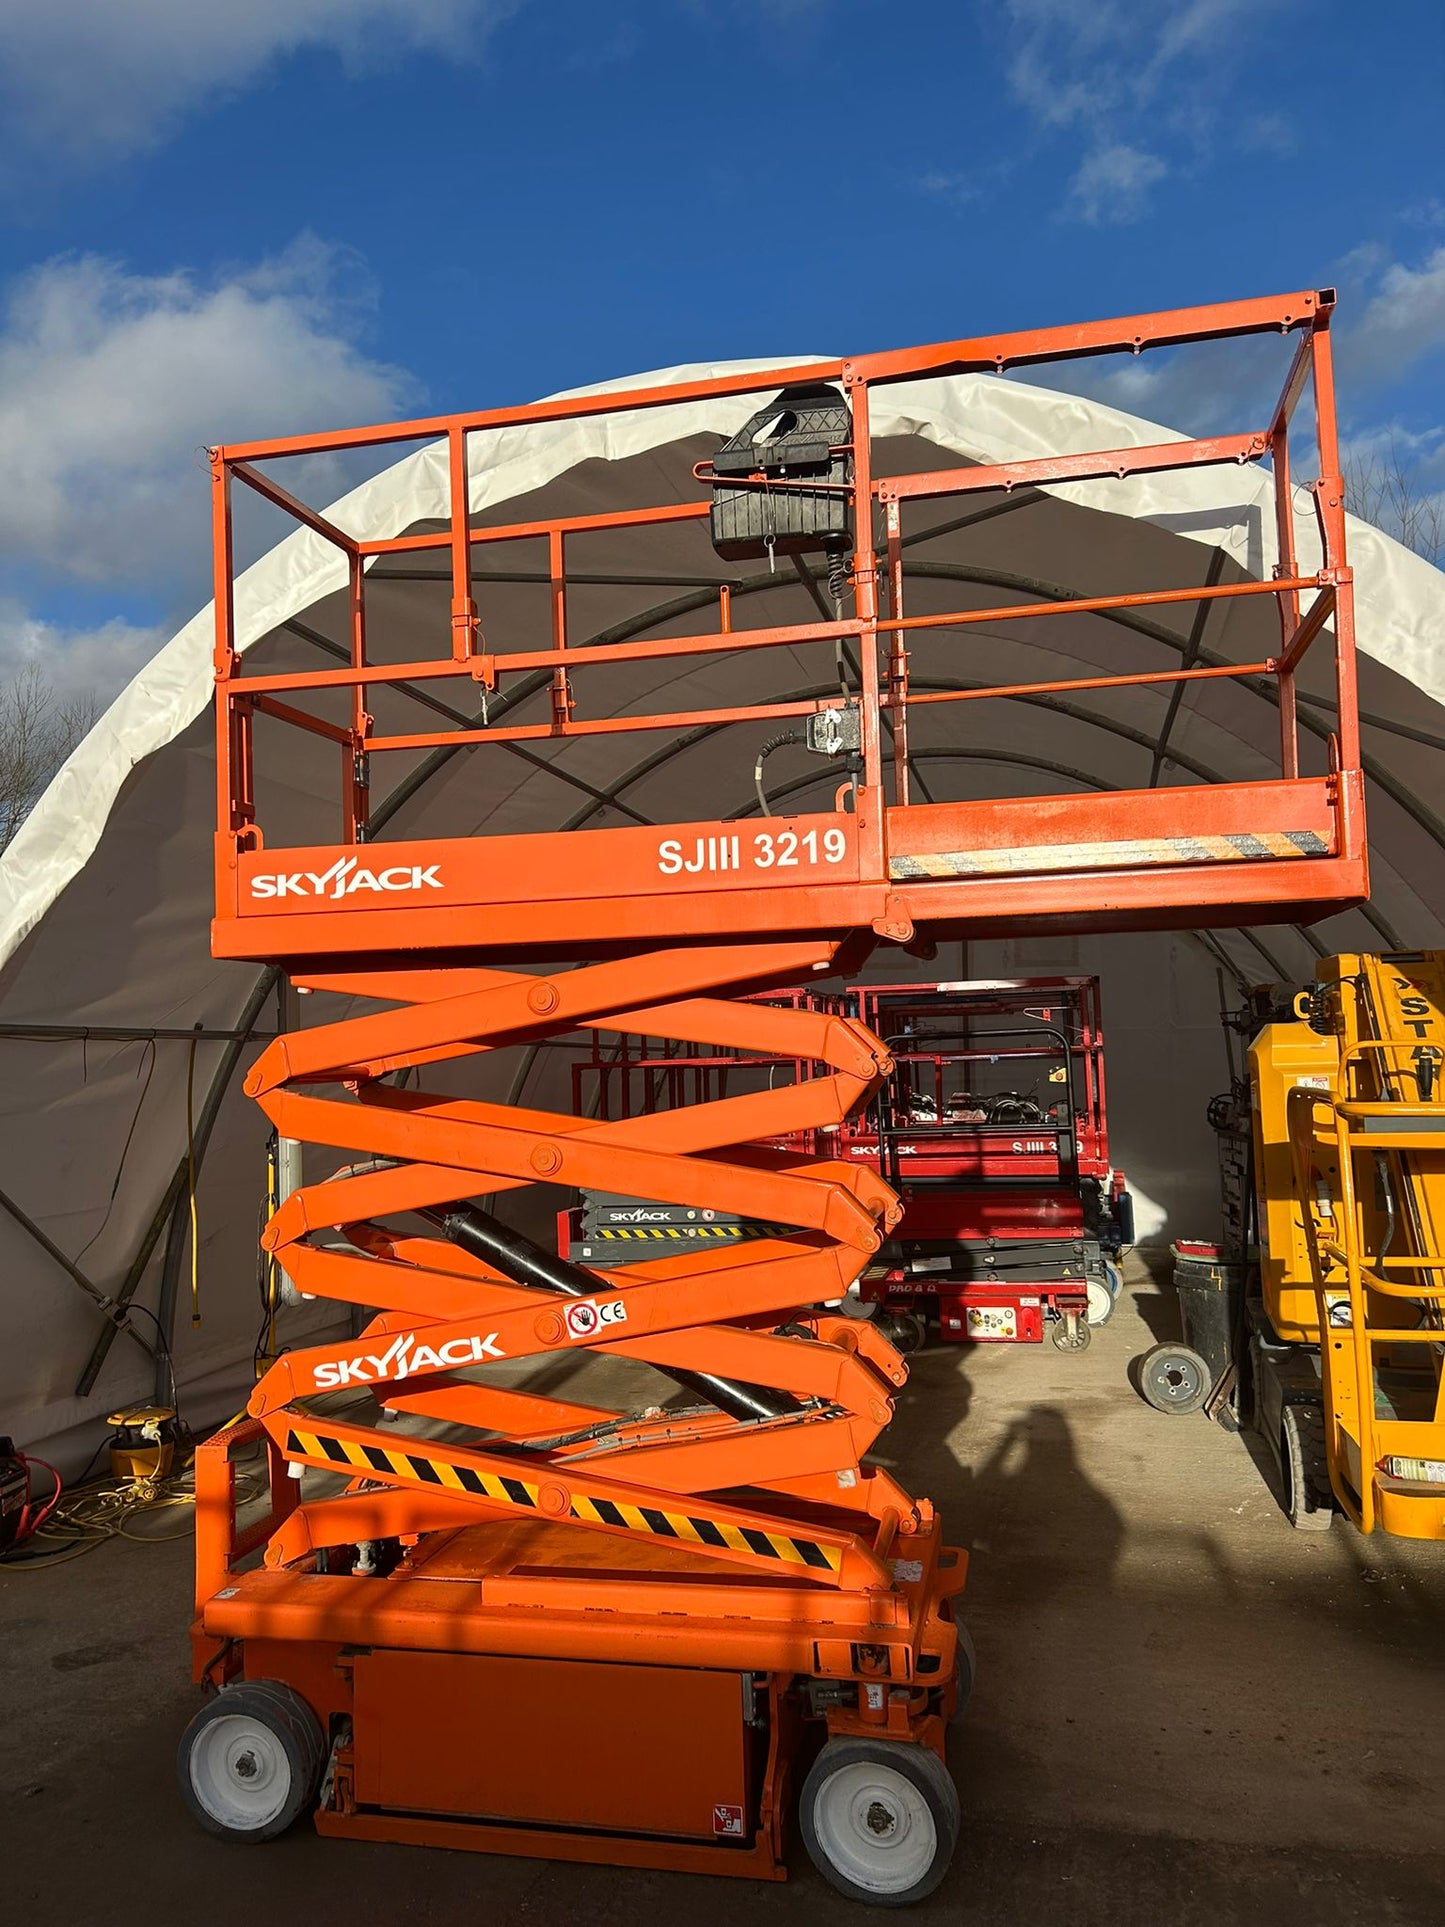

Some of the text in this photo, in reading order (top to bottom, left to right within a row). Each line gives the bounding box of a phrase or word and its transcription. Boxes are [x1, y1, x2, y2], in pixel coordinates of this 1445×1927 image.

[658, 829, 846, 874] SJIII 3219
[251, 855, 445, 899] SKYJACK
[1048, 1140, 1084, 1154] 39
[609, 1208, 671, 1222] SKYJACK
[600, 1302, 625, 1322] CE
[313, 1332, 506, 1388] SKYJACK
